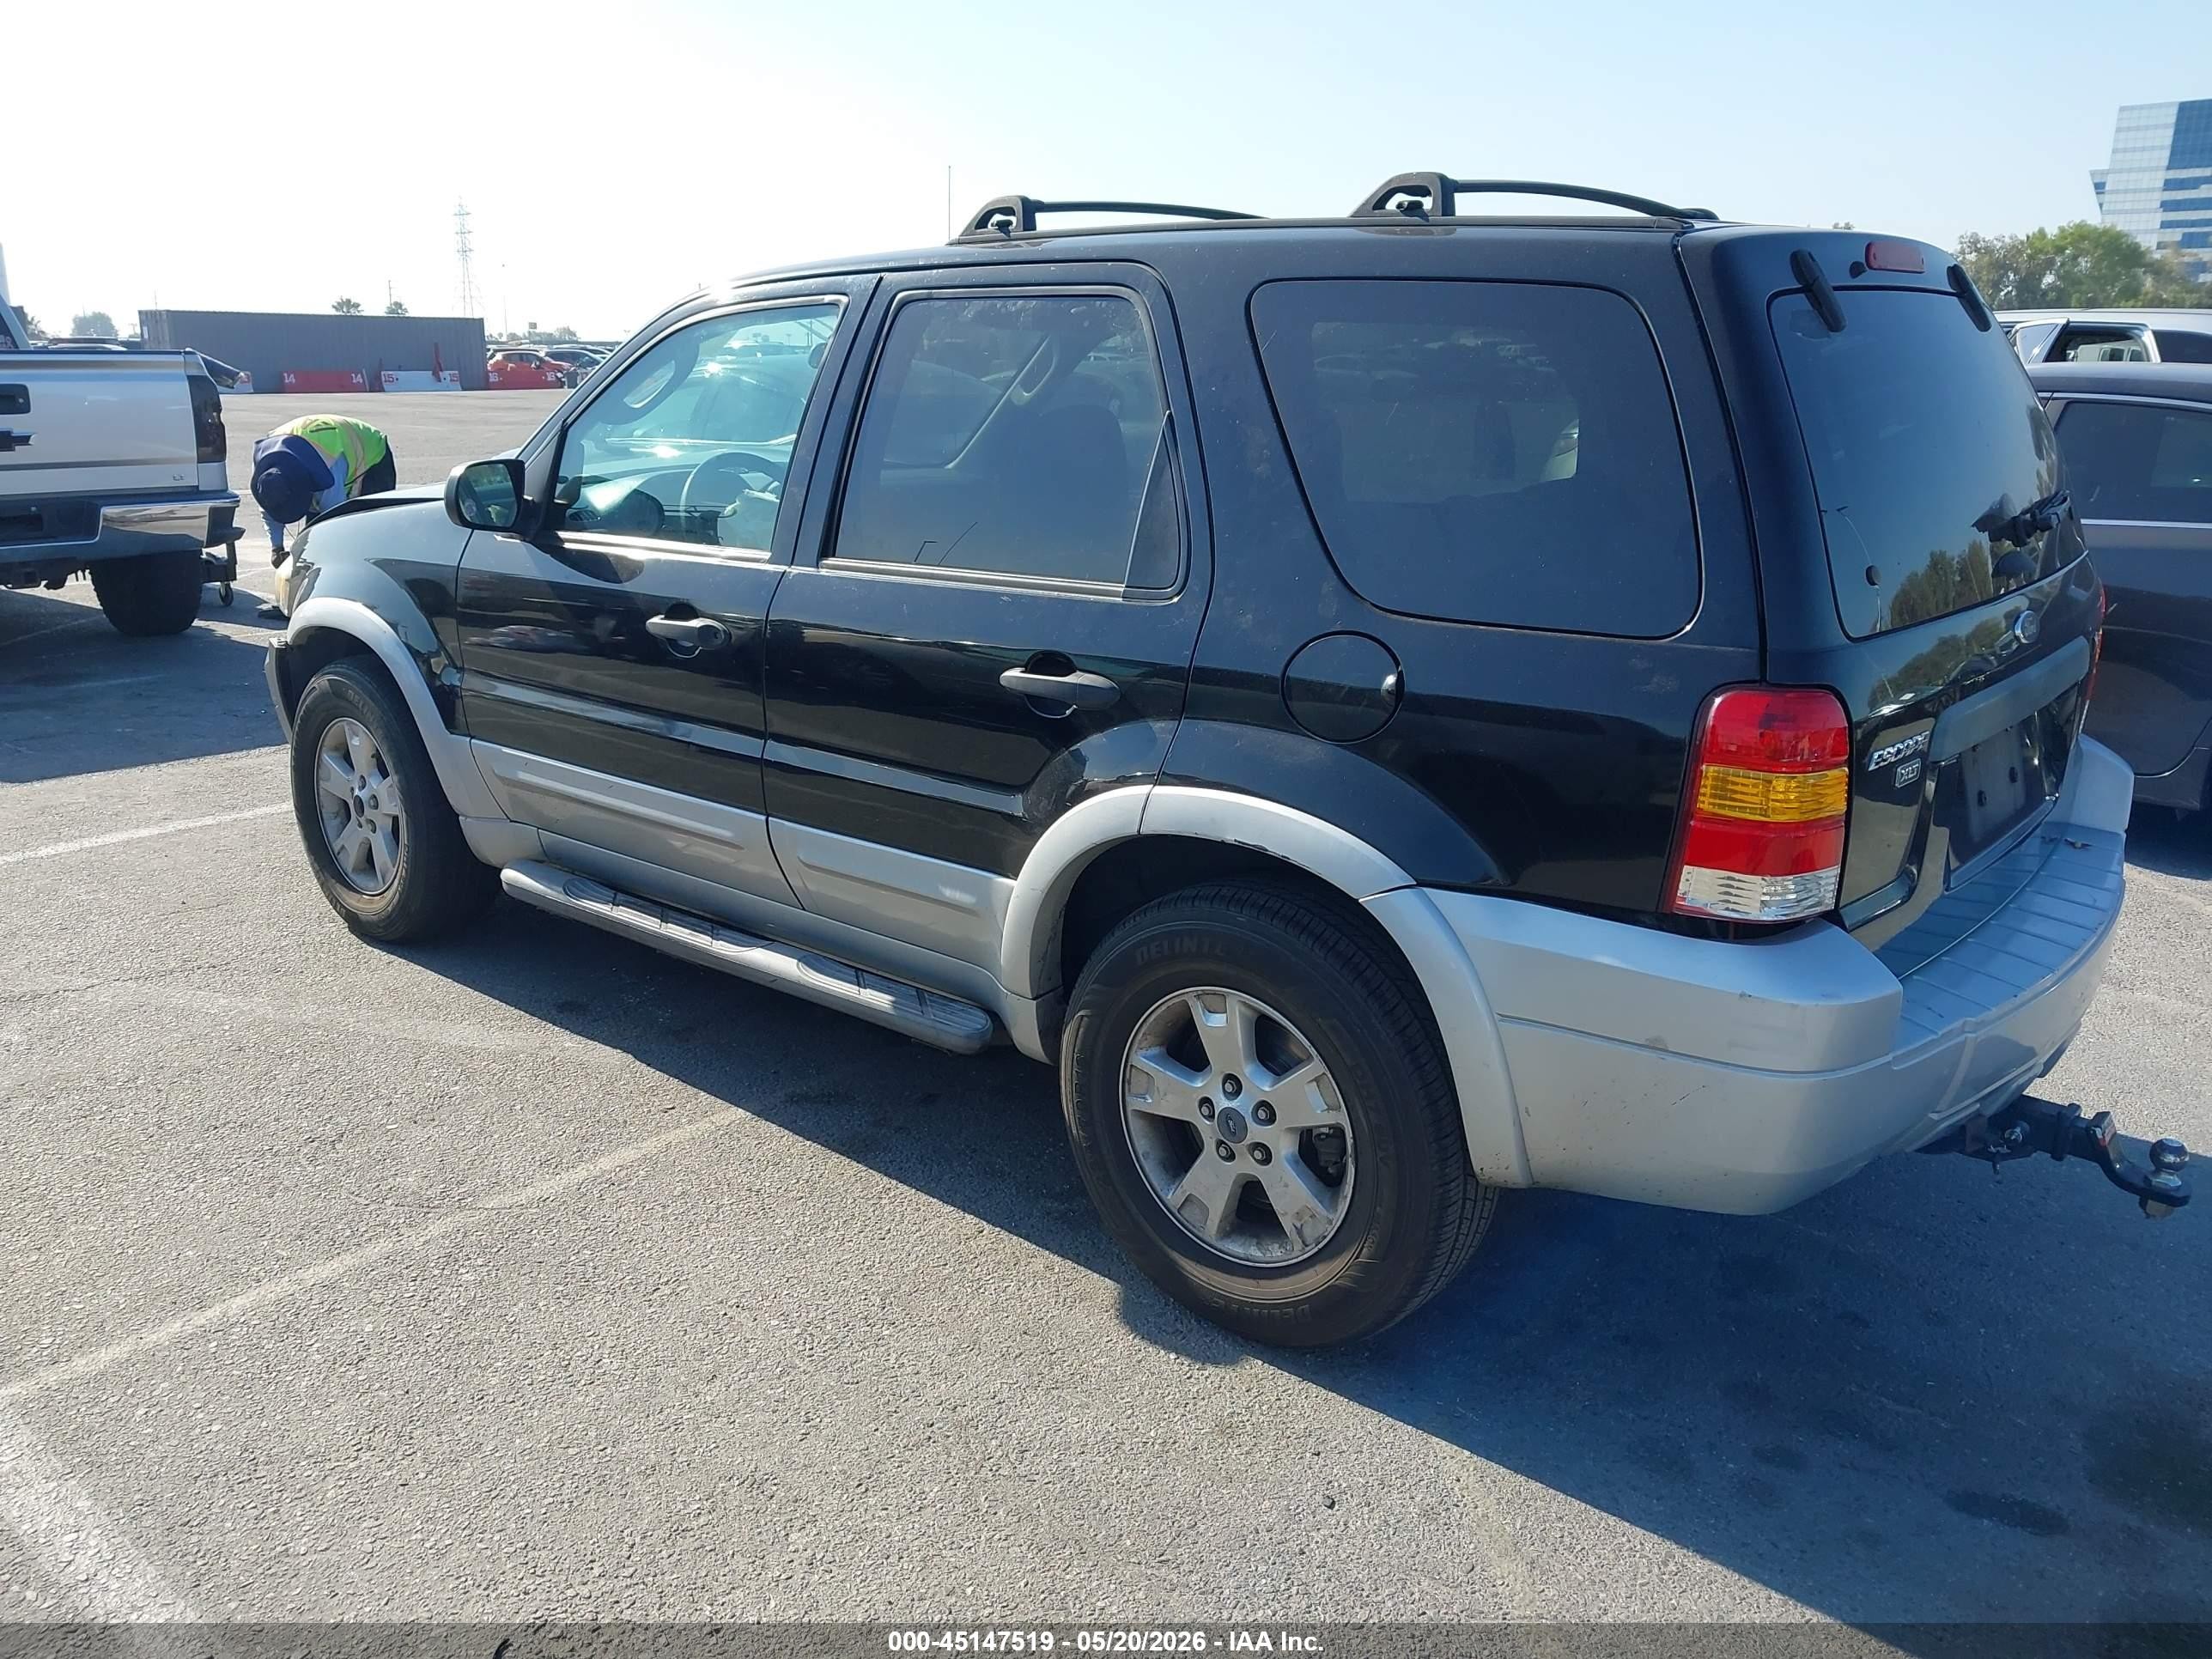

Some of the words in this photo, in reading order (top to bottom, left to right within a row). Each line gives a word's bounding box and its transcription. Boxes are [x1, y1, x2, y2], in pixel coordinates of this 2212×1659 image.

[283, 373, 296, 384] 14
[350, 373, 363, 384] 14
[383, 373, 395, 383] 15
[449, 373, 459, 383] 15
[1868, 731, 1930, 771] ESCAPE
[1899, 763, 1919, 782] XLT
